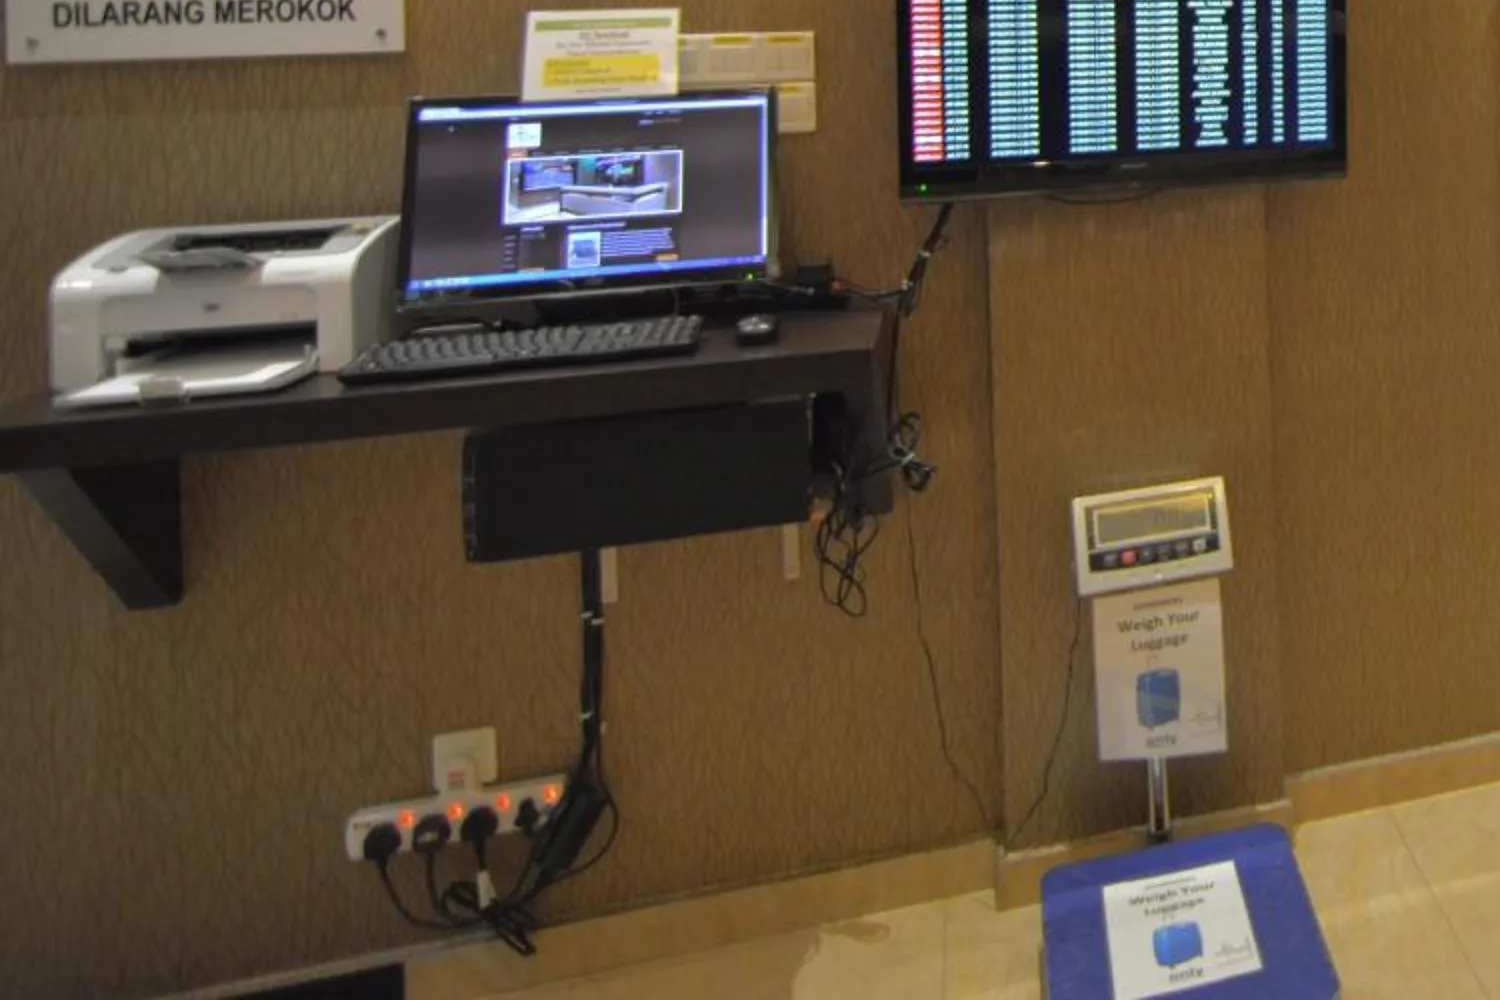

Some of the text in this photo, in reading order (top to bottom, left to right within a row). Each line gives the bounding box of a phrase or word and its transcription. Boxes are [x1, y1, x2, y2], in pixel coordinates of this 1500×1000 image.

[1116, 609, 1201, 634] Weigh Your
[1130, 633, 1190, 653] Luggage
[1127, 888, 1177, 905] Weigh
[1180, 880, 1215, 896] Your
[1143, 897, 1206, 917] Luggage
